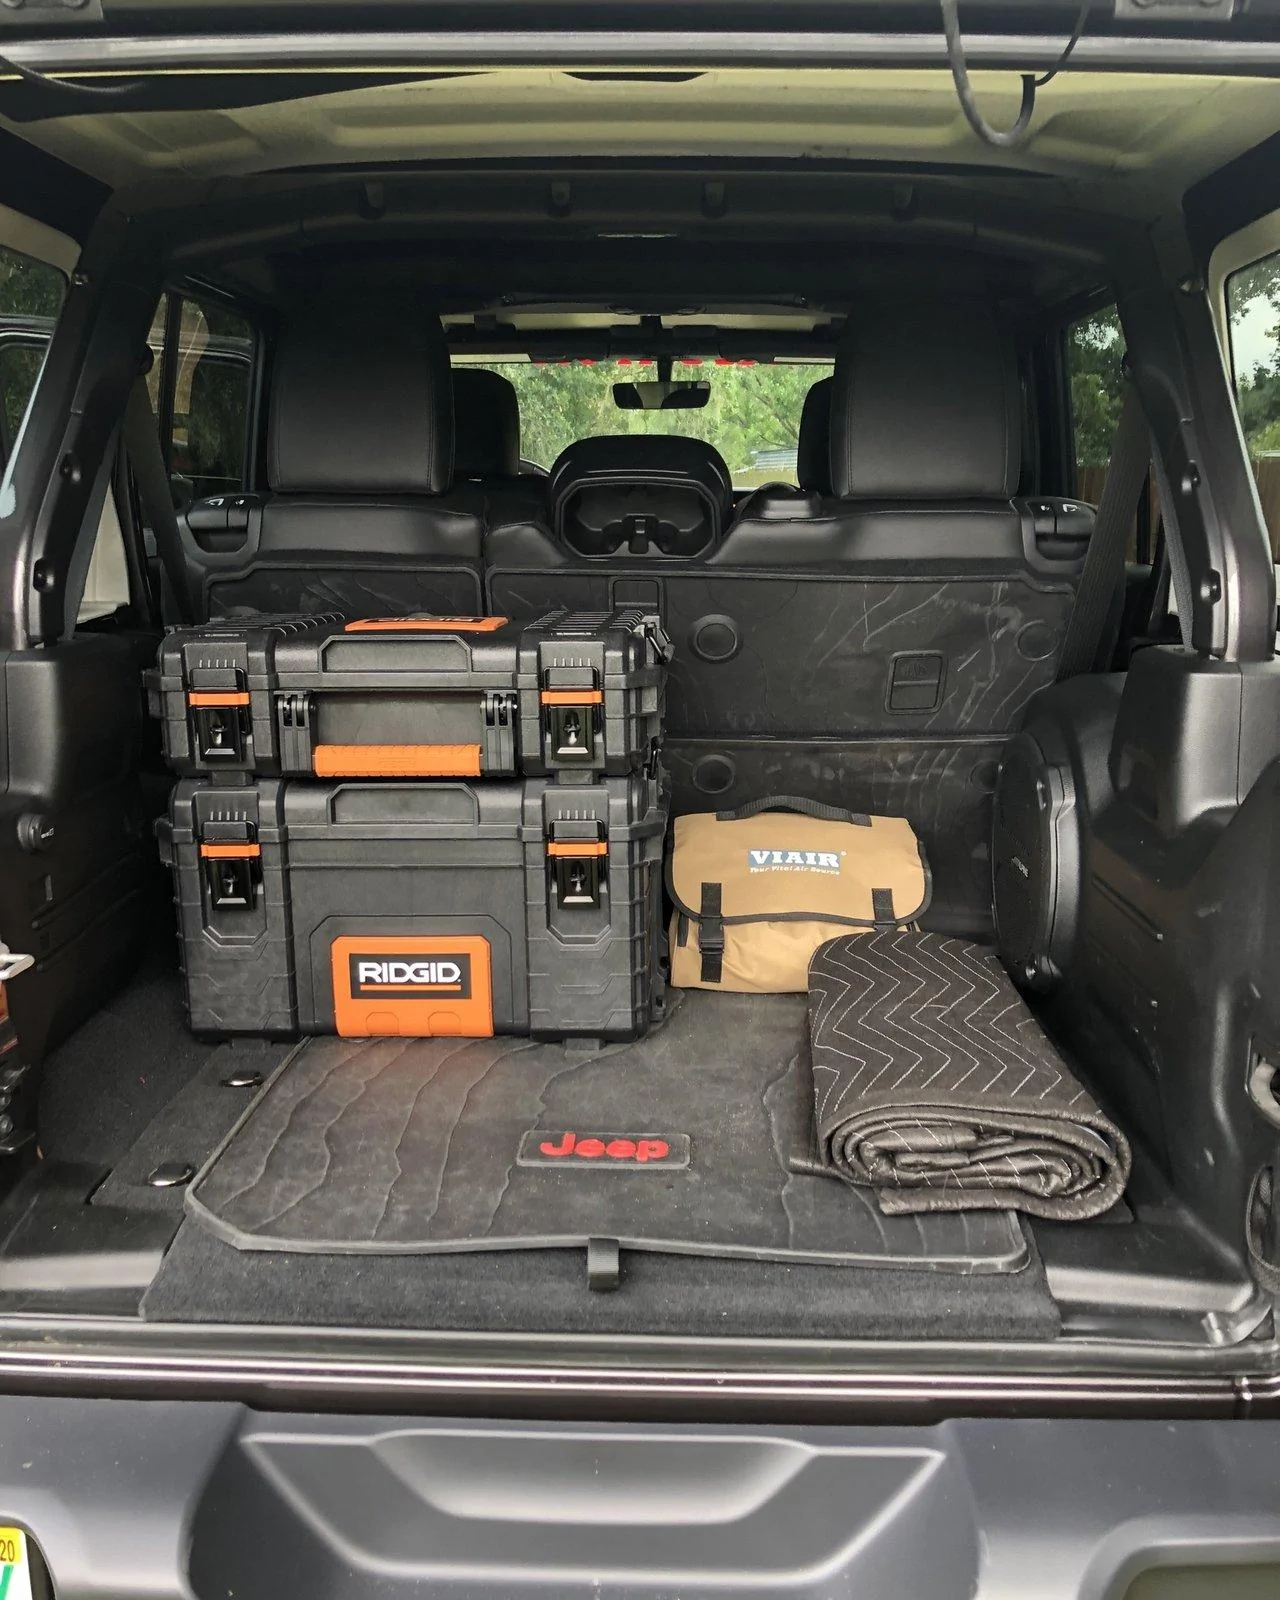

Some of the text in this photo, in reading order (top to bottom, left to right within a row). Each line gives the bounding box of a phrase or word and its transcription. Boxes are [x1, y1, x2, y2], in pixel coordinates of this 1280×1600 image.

[750, 850, 839, 868] VIAIR
[794, 865, 808, 873] Air
[358, 962, 461, 983] RIDGID
[539, 1131, 670, 1164] Jeep
